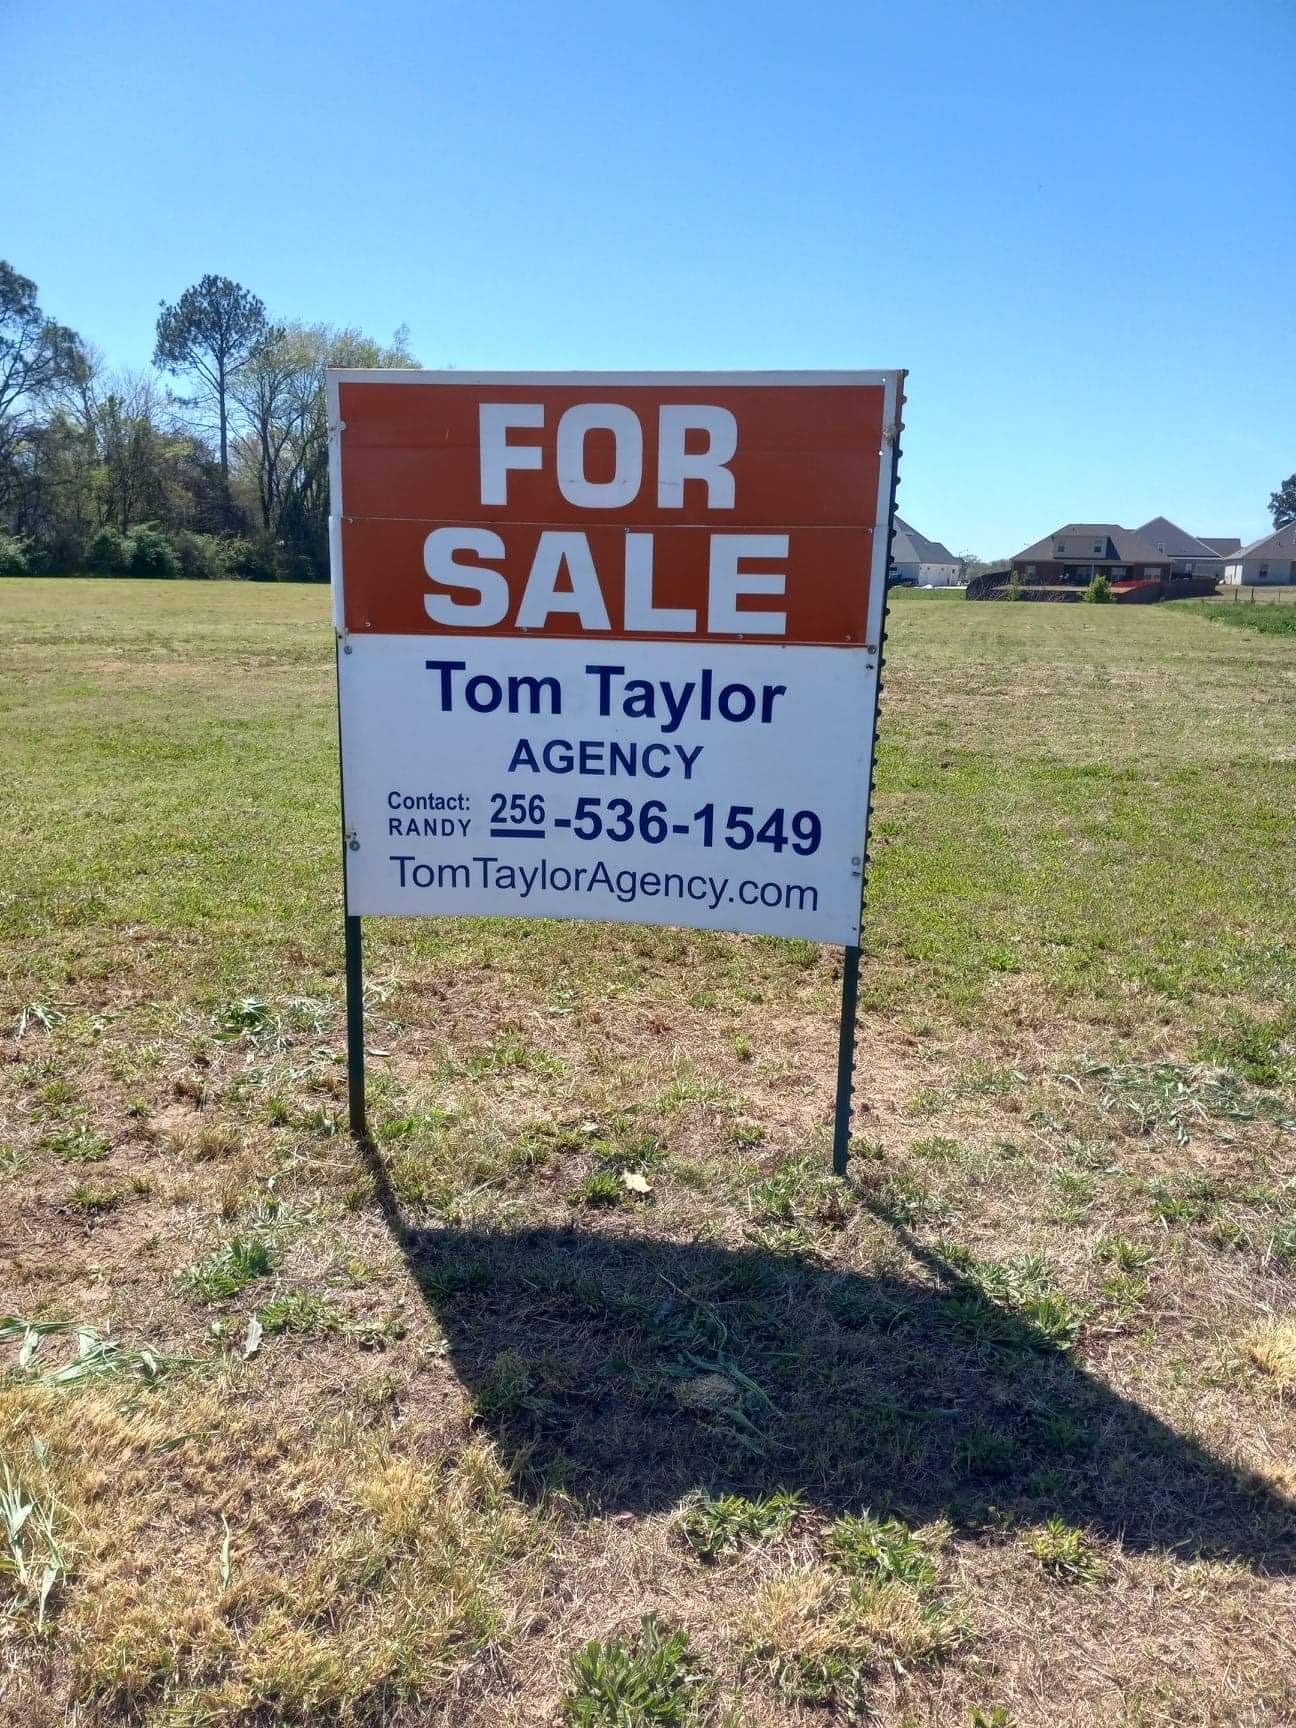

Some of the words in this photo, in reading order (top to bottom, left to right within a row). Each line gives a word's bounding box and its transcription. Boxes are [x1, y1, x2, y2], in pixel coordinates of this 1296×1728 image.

[479, 402, 738, 509] FOR
[423, 527, 790, 635] SALE
[425, 660, 562, 715] Tom
[585, 664, 787, 733] Taylor
[507, 738, 704, 779] AGENCY
[387, 791, 471, 812] Contact:
[388, 817, 472, 838] RANDY
[389, 856, 819, 911] TomTaylorAgency.com
